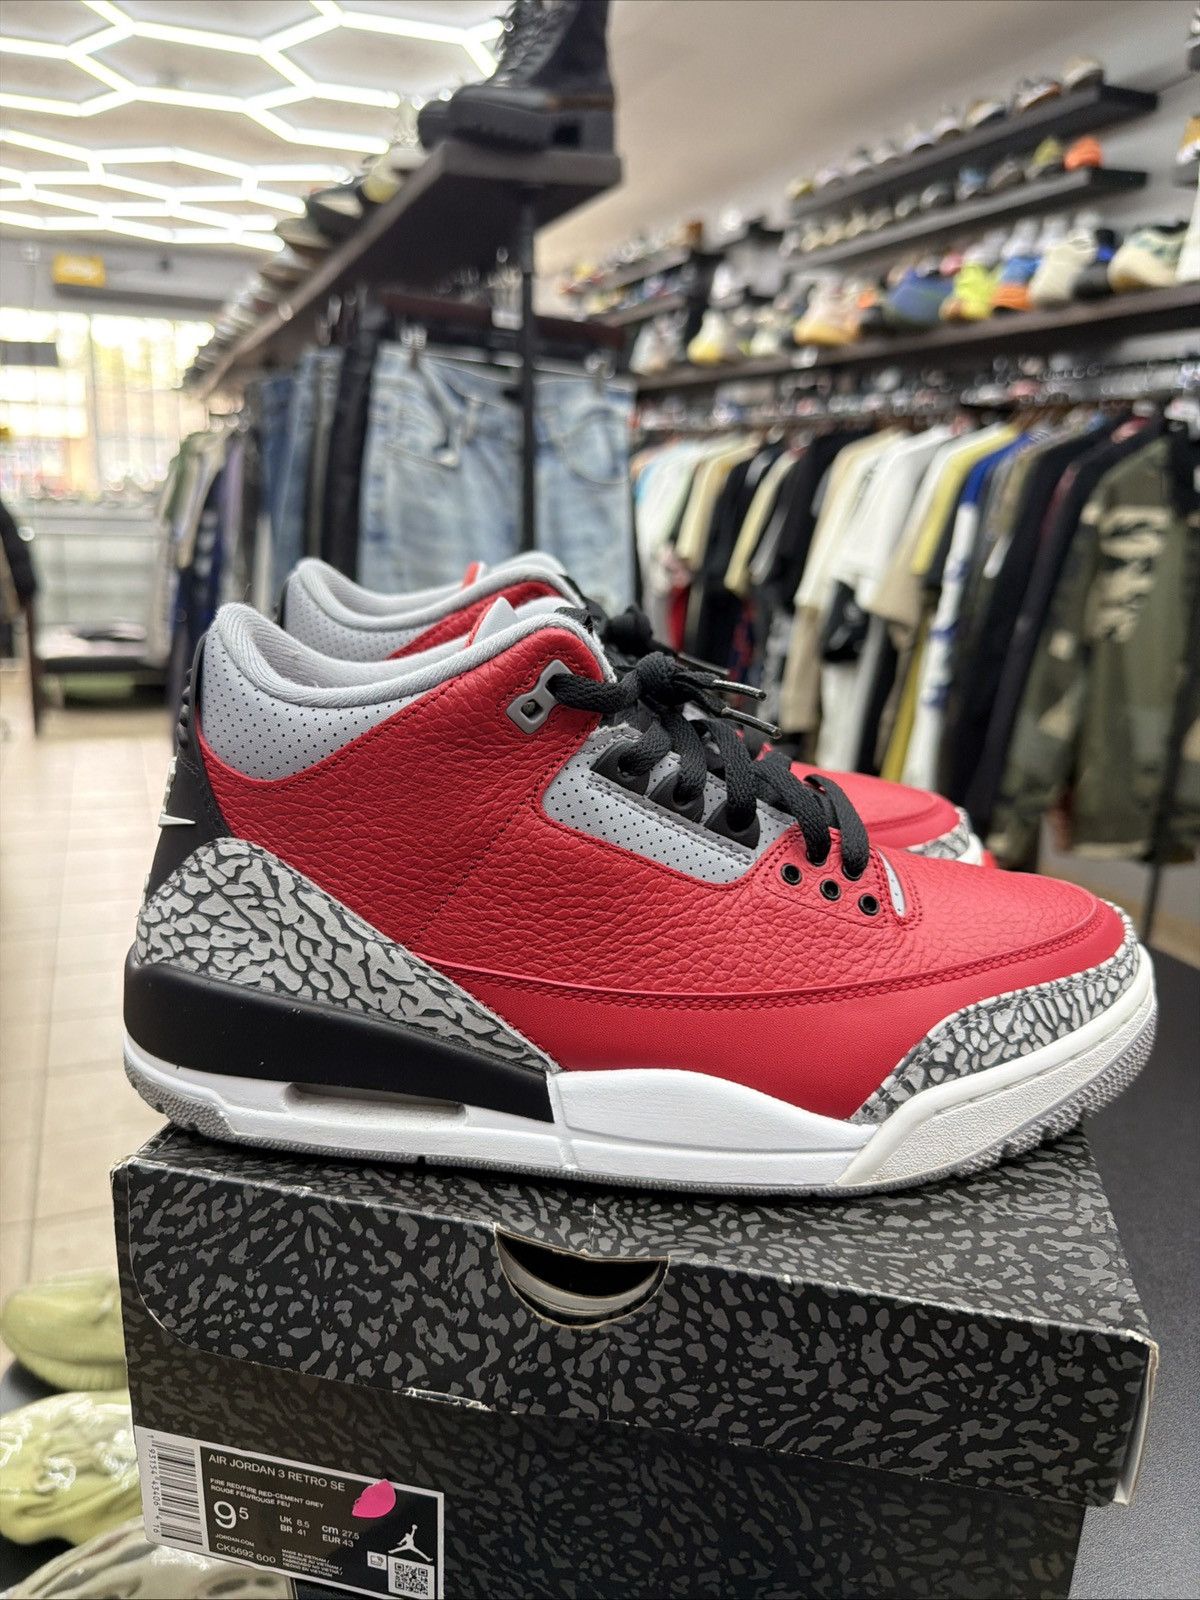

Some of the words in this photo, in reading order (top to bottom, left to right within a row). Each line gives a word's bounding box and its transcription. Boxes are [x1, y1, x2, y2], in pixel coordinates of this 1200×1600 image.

[209, 1454, 227, 1465] AIR
[230, 1459, 276, 1476] JORDAN
[278, 1470, 285, 1479] 3
[288, 1471, 328, 1487] RETRO
[330, 1480, 346, 1492] SE
[210, 1485, 234, 1494] ROUGE
[210, 1478, 225, 1486] FIRE
[226, 1482, 258, 1494] RED/FIRE
[258, 1490, 303, 1504] RED-CEMENT
[305, 1500, 324, 1508] GREY
[213, 1500, 237, 1529] 9
[239, 1506, 249, 1520] 5
[280, 1515, 292, 1525] UK
[296, 1519, 310, 1529] 8.5
[280, 1524, 293, 1534] BR
[297, 1528, 306, 1536] 41
[322, 1525, 339, 1535] cm
[342, 1530, 360, 1540] 27.5
[322, 1534, 341, 1545] EUR
[342, 1539, 354, 1548] 43
[216, 1543, 254, 1559] CK5692
[256, 1554, 276, 1564] 600
